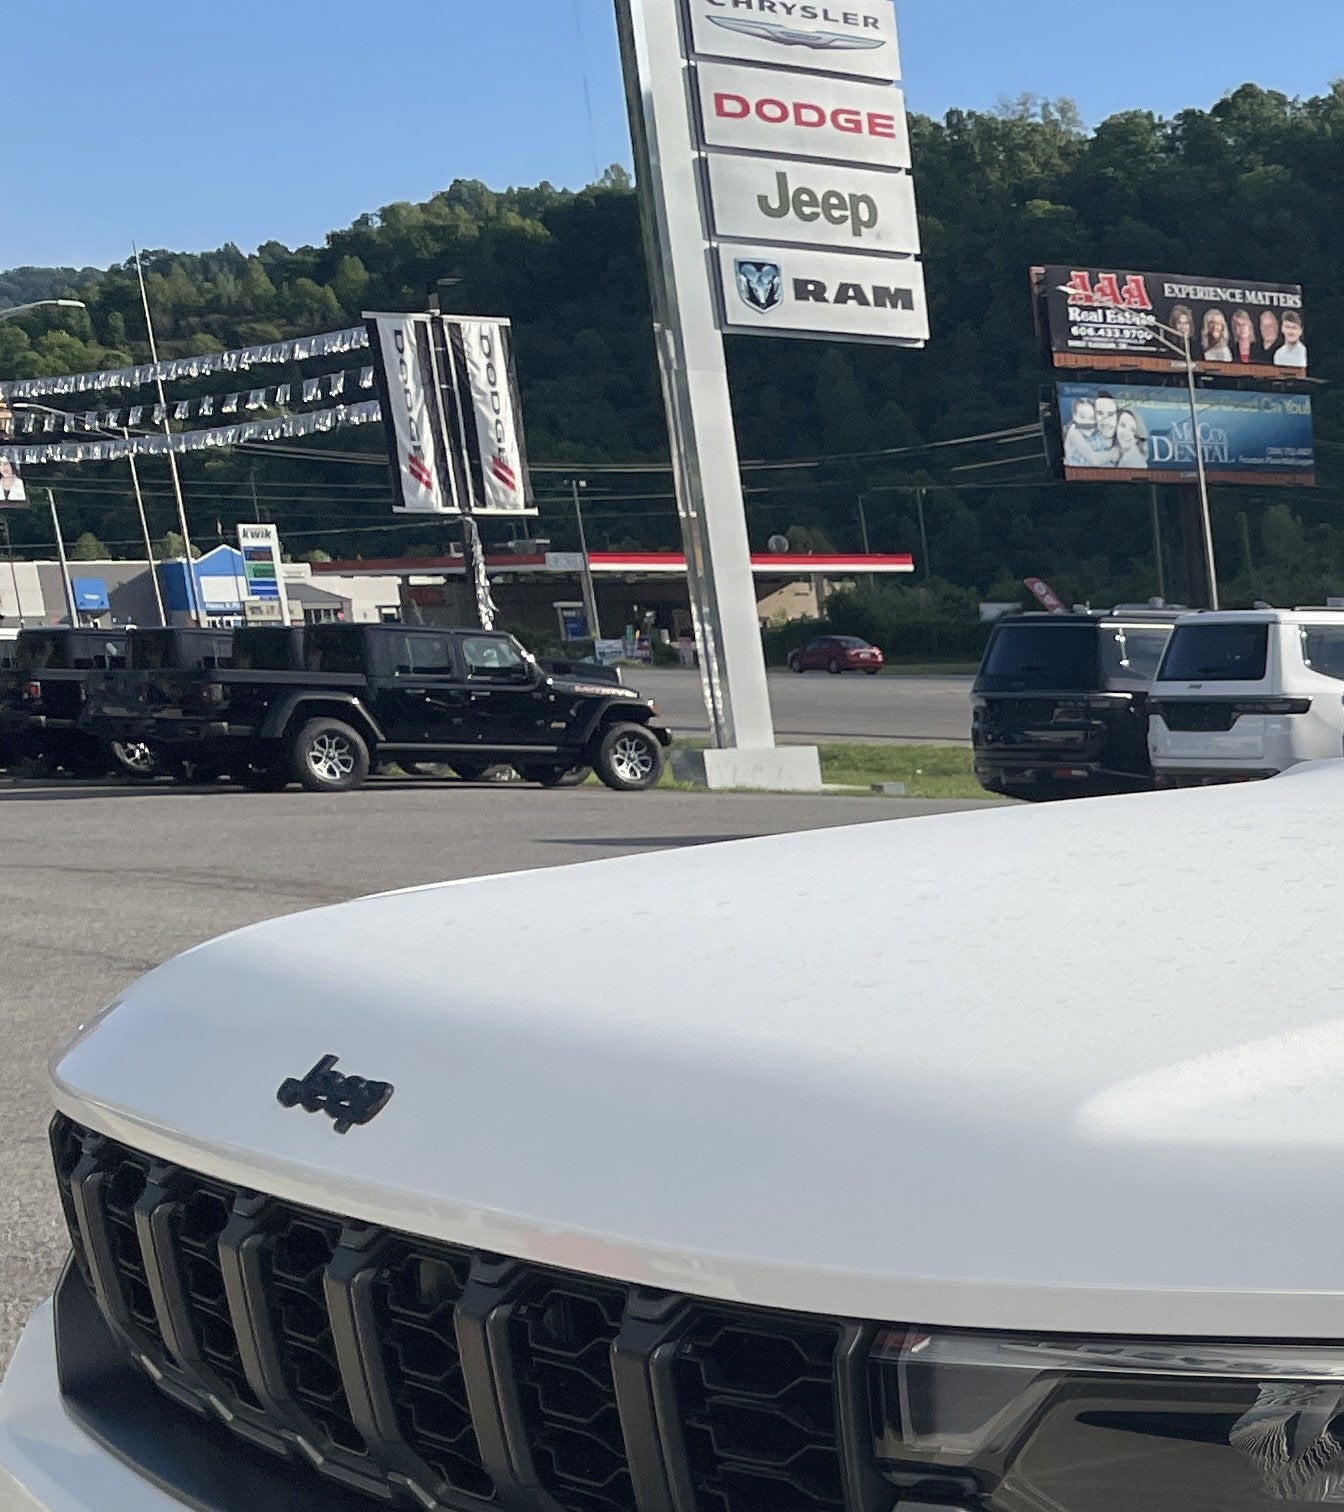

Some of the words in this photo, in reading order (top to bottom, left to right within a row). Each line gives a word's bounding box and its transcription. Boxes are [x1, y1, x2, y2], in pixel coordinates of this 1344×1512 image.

[713, 92, 897, 139] DODGE
[757, 171, 878, 237] Jeep
[793, 277, 915, 311] RAM
[1163, 282, 1242, 303] EXPERIENCE
[1245, 289, 1303, 308] MATTERS
[1068, 306, 1104, 322] Real
[1105, 309, 1156, 326] Estate
